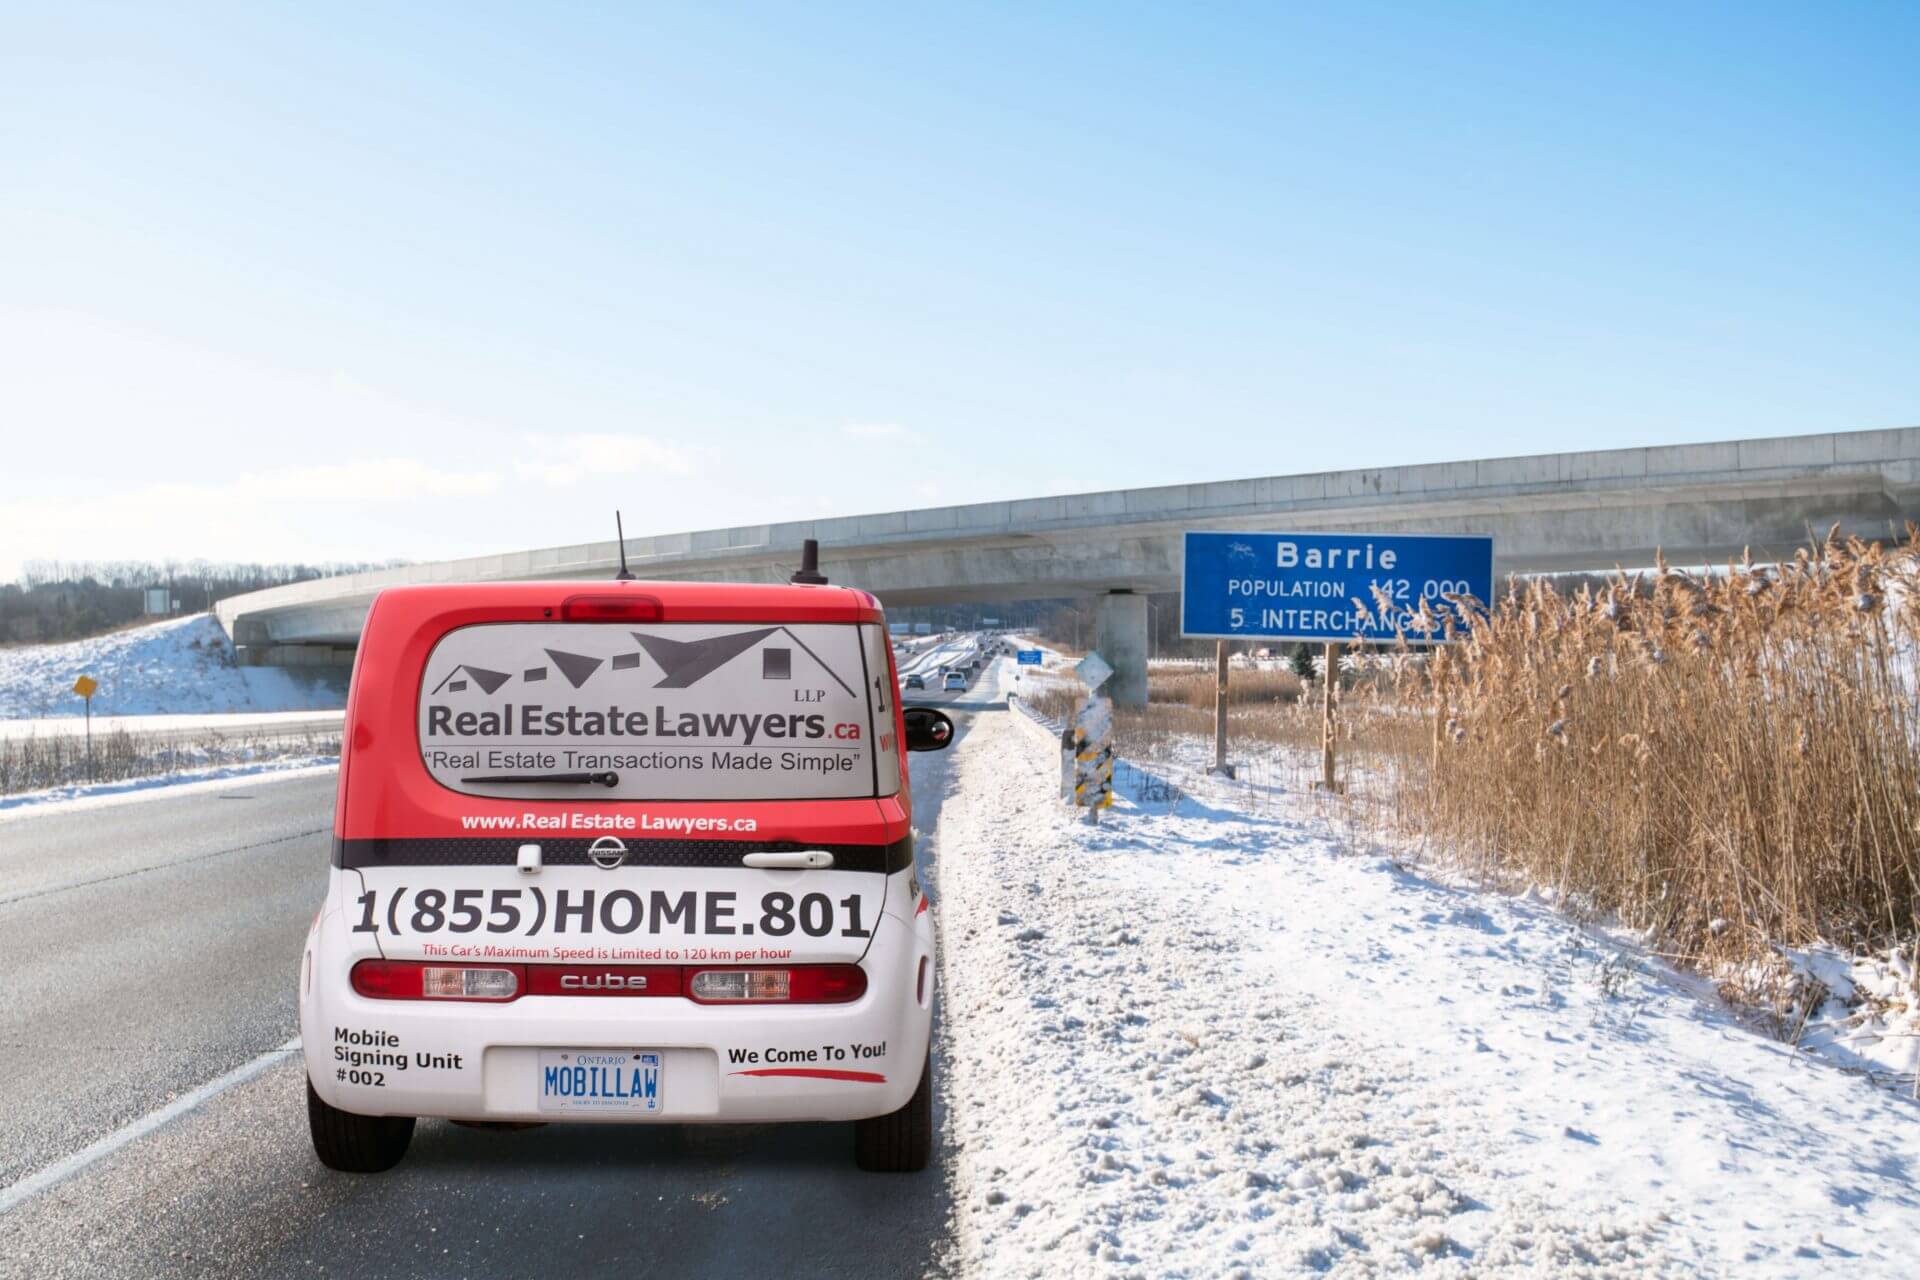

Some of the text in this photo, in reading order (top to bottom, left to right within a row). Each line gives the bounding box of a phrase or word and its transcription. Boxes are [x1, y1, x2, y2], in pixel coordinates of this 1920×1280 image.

[1276, 541, 1398, 570] Barrie
[1228, 579, 1345, 598] POPULATION
[1368, 579, 1410, 599] 142
[1230, 608, 1244, 629] 5
[794, 689, 826, 702] LLP
[488, 751, 556, 769] Estate
[563, 751, 703, 769] Transactions
[711, 752, 772, 770] Made
[571, 813, 636, 829] Estate
[352, 886, 871, 938] 1(855)HOME.801
[423, 944, 792, 962] This Car's Maximum Speed is Limited to 120 km per hour
[560, 973, 647, 989] cube
[334, 1026, 400, 1047] Mobile
[334, 1046, 463, 1070] Signing Unit
[577, 1055, 626, 1065] ONTARIO
[728, 1041, 887, 1063] We Come To You!
[336, 1067, 386, 1087] #002
[545, 1066, 657, 1098] MOBILLAW
